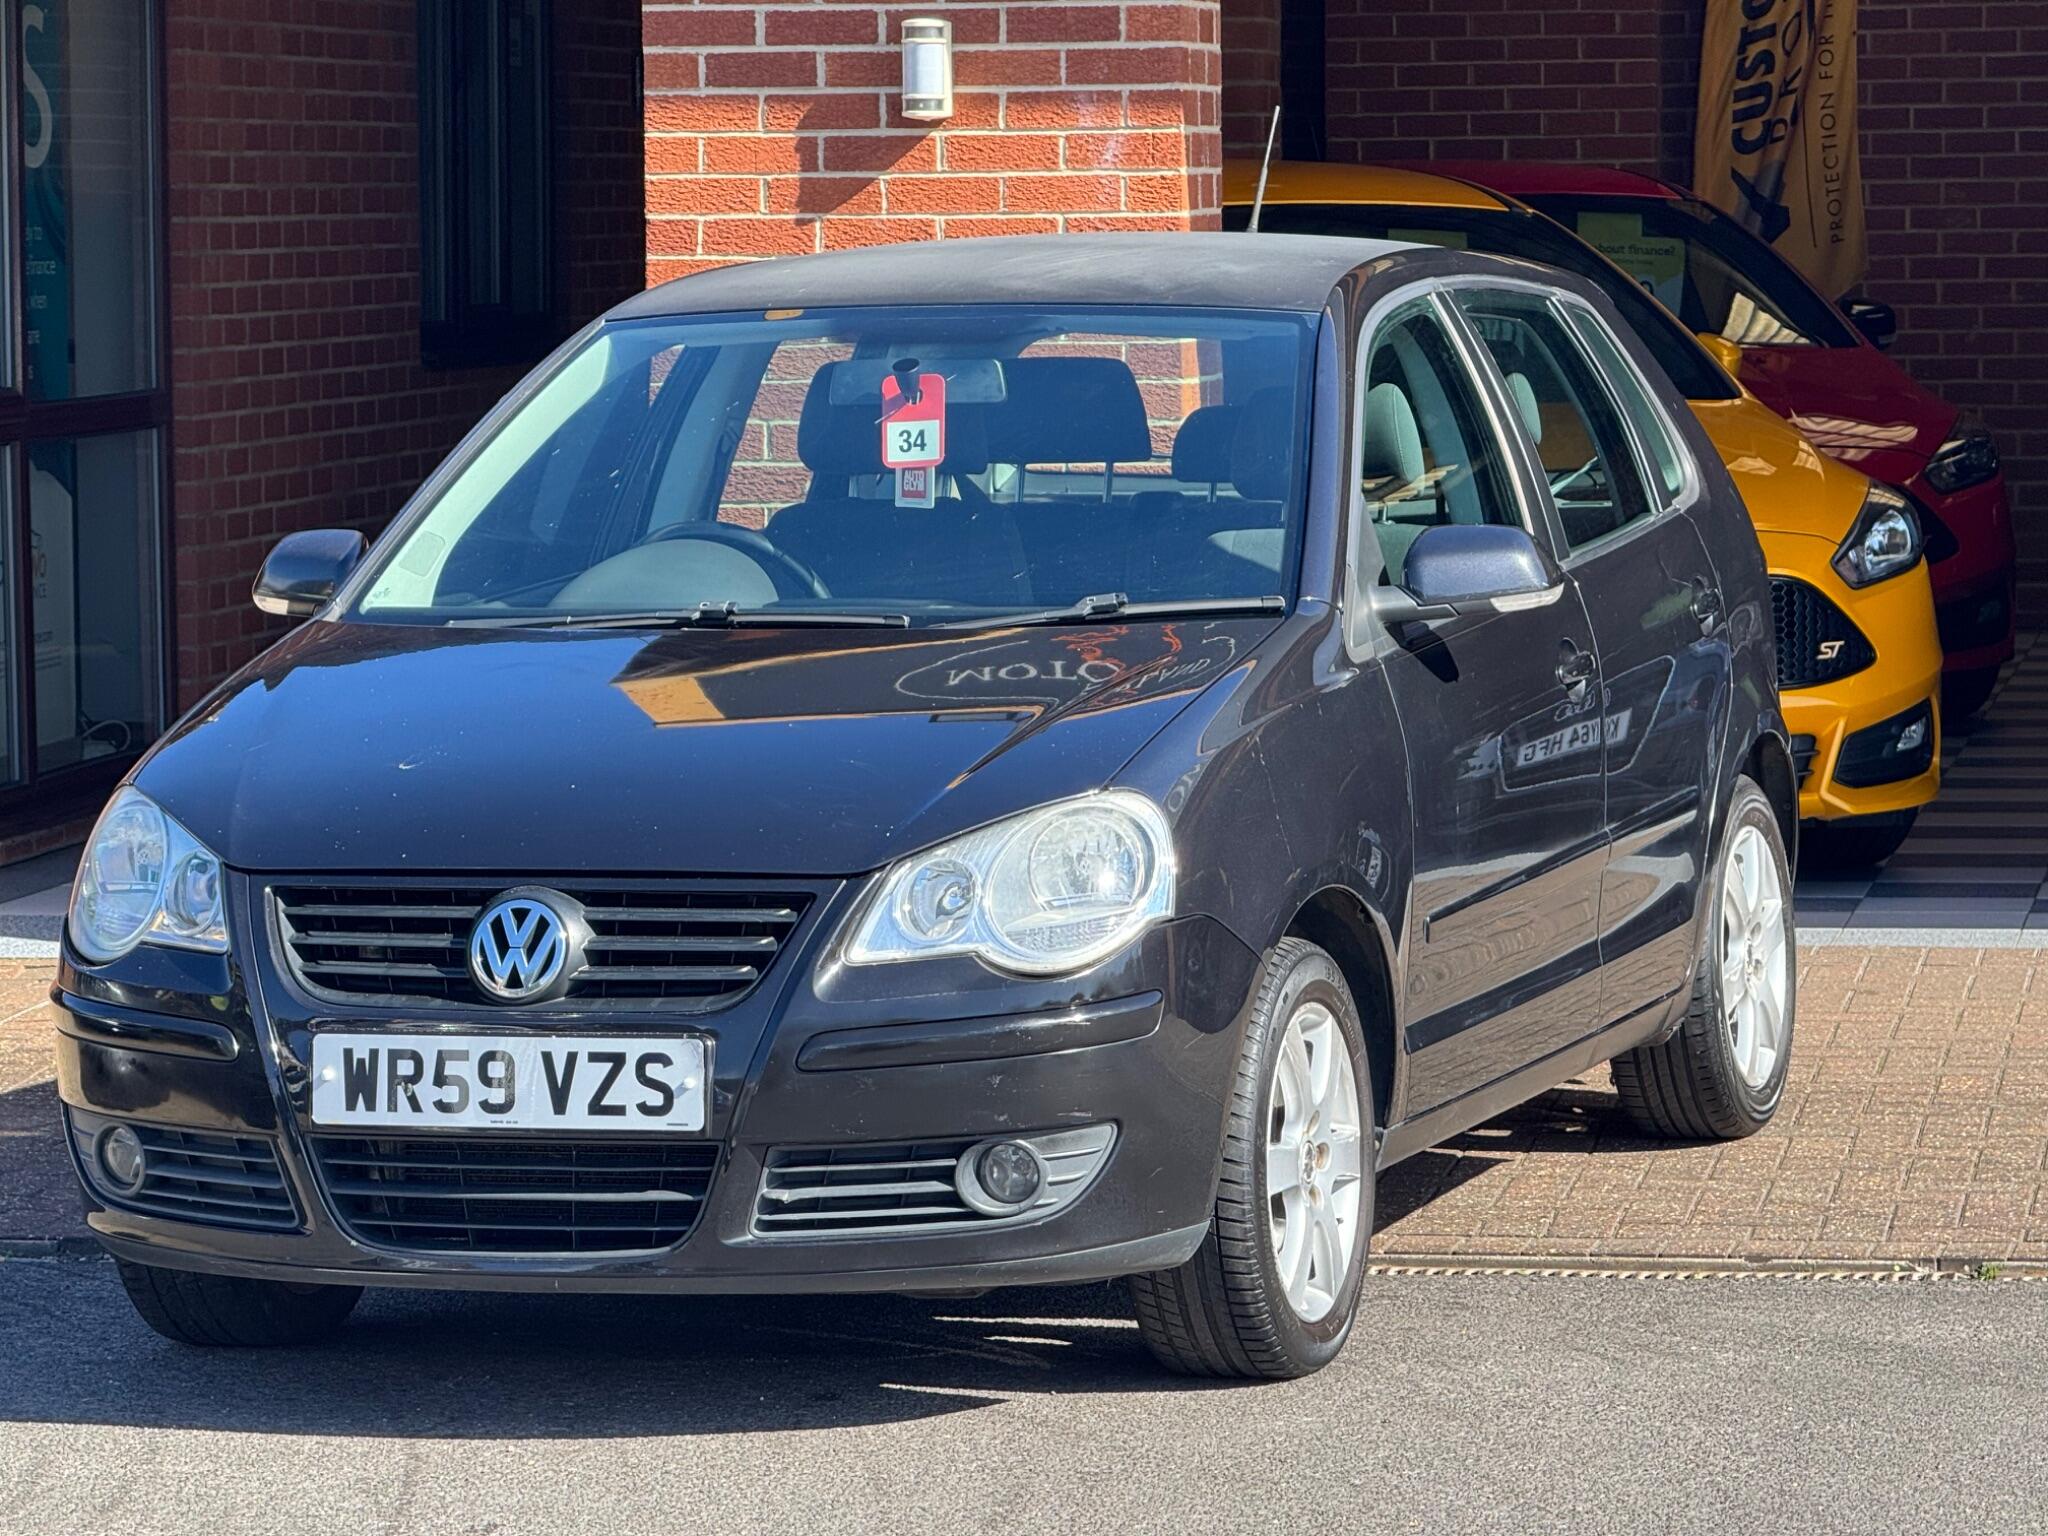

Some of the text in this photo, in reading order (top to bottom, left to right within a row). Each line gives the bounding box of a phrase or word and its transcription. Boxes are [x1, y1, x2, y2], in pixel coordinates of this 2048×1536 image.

[1818, 34, 1834, 80] FOR
[1819, 93, 1845, 245] PROTECTION
[898, 429, 927, 453] 34
[904, 470, 925, 481] AUTO
[1815, 640, 1846, 660] ST
[343, 1047, 675, 1117] WR59 VZS
